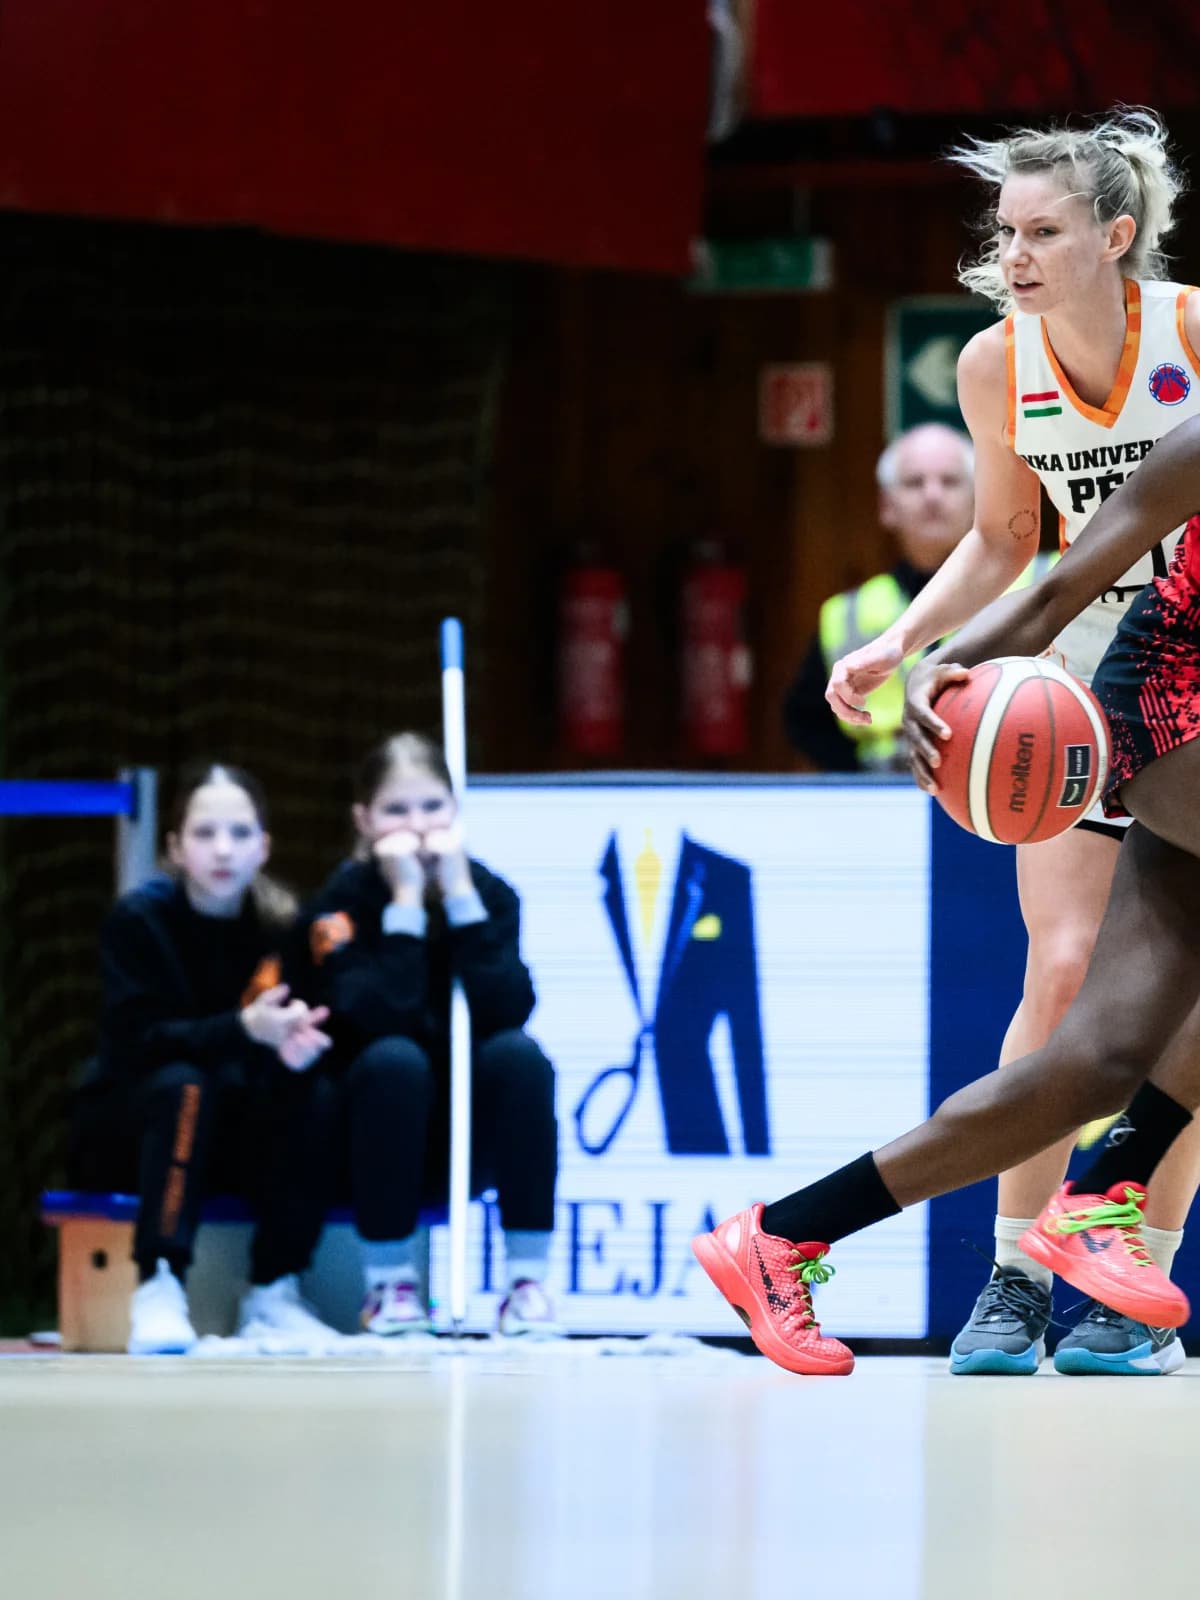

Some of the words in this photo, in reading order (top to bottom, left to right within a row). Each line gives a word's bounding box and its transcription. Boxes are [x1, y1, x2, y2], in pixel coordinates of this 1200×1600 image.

[1066, 438, 1163, 472] UNIVER
[1067, 469, 1137, 514] PÉ
[1009, 732, 1036, 813] molten
